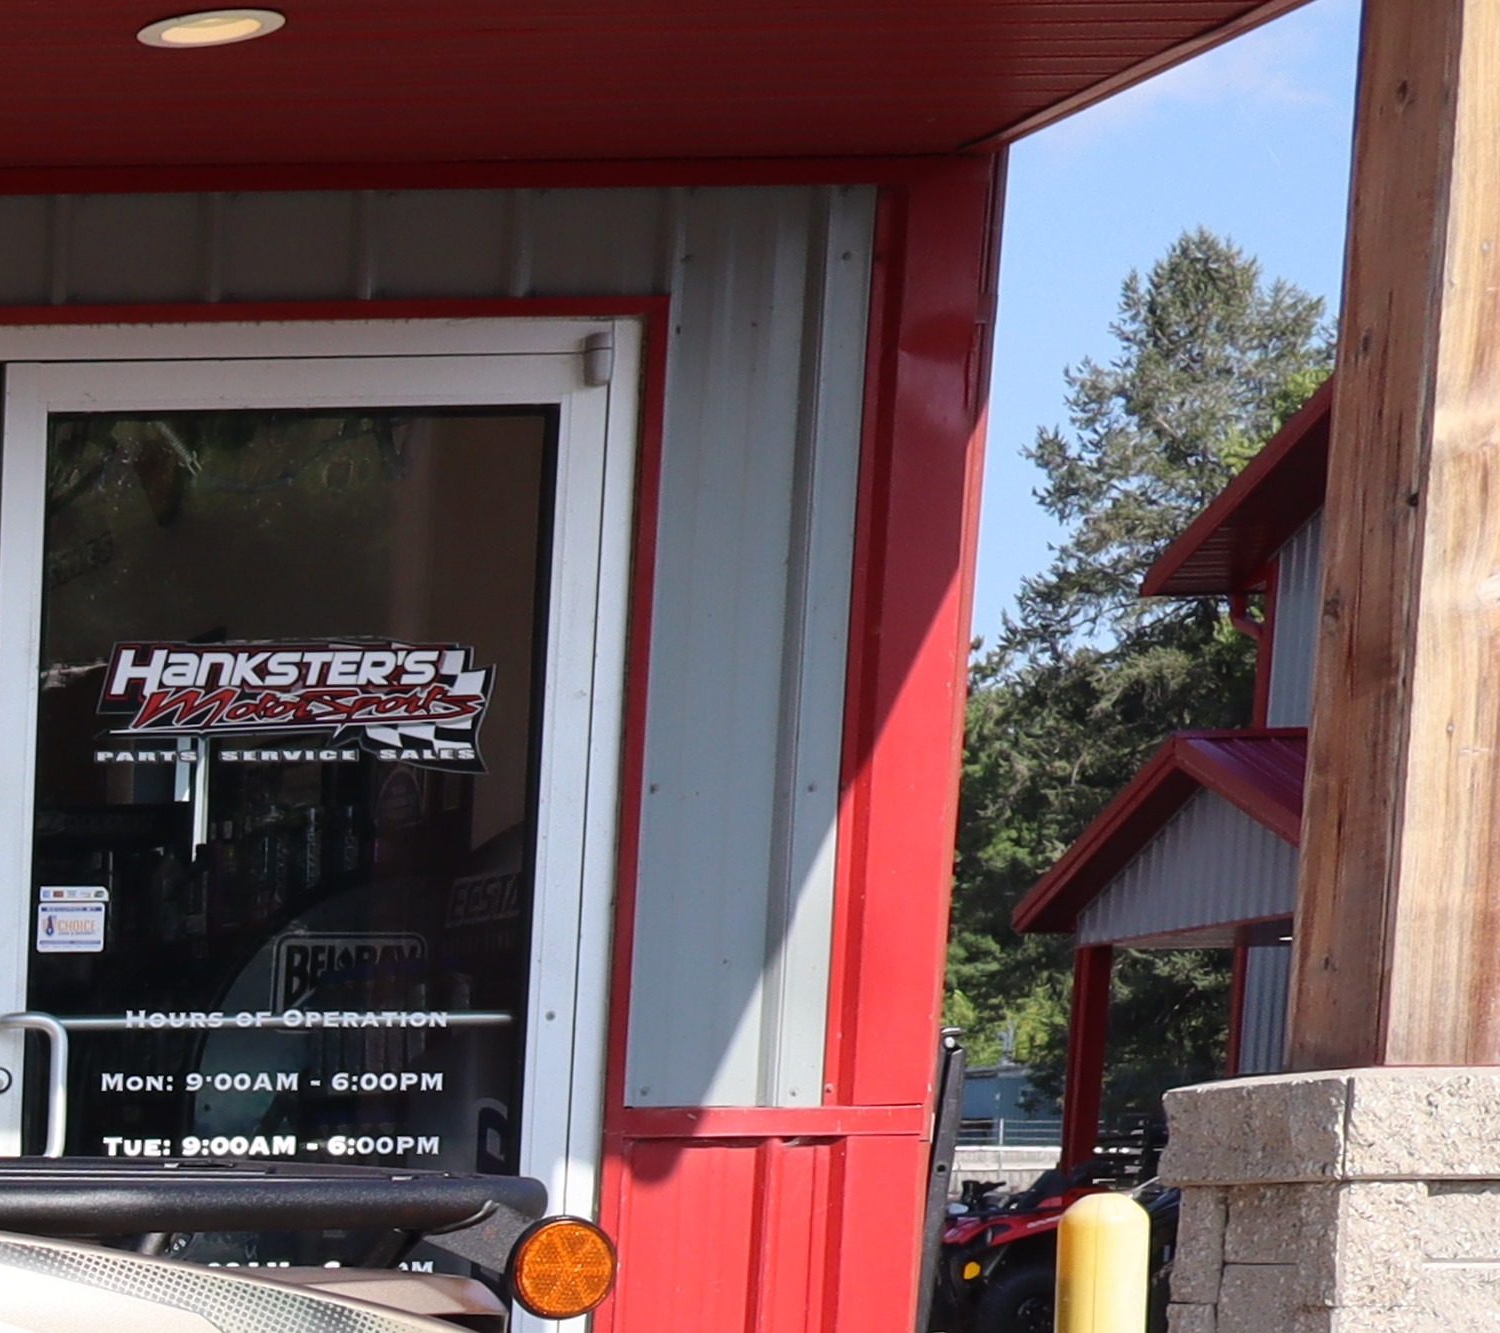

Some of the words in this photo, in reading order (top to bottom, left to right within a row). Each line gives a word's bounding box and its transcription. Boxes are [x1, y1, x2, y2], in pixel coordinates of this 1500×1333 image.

[96, 750, 198, 762] PARTS
[219, 750, 360, 762] SERVICE
[378, 748, 477, 761] SALES
[58, 920, 96, 932] CHOICE
[331, 1072, 444, 1091] 6:00PM
[181, 1136, 297, 1156] 9:00AM
[327, 1135, 440, 1156] 6:00PM
